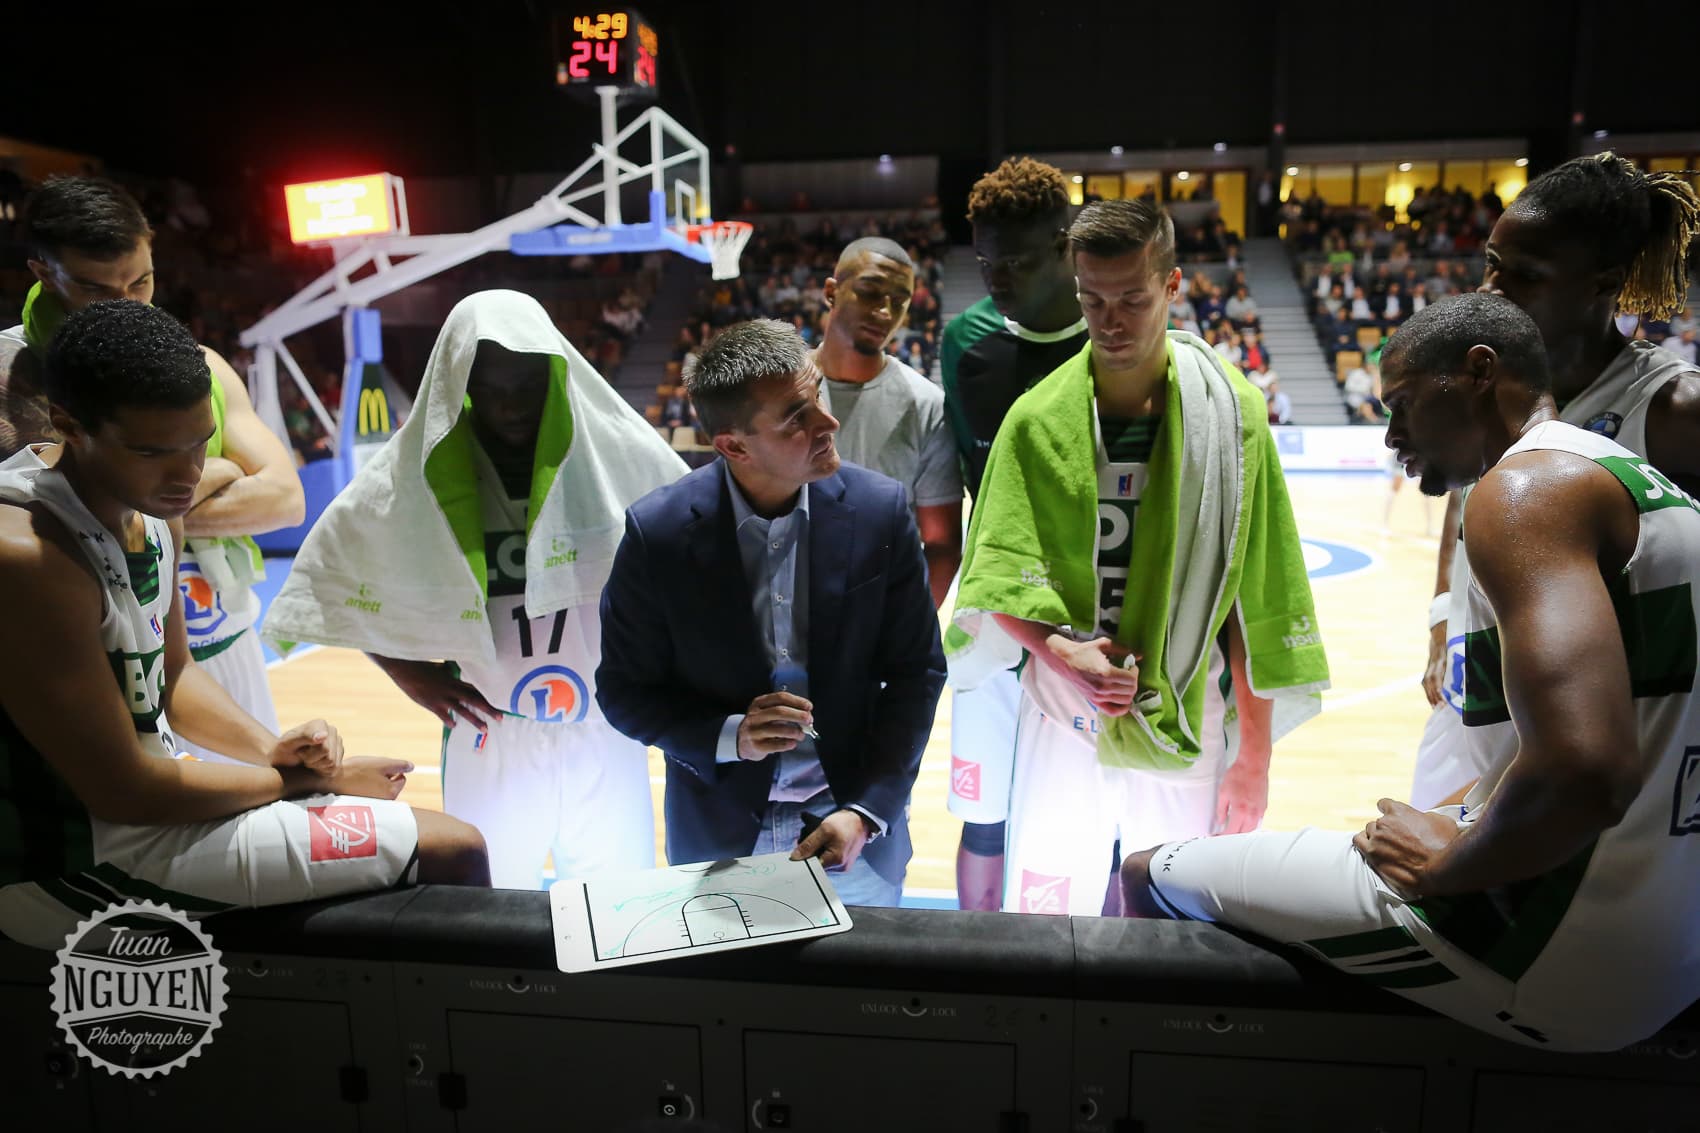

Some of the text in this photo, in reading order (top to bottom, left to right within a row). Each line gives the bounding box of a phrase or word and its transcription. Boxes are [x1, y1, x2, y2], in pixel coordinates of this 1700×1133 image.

[569, 40, 618, 78] 24
[512, 605, 568, 658] 17
[861, 1003, 957, 1017] UNLOCK LOCK
[1163, 1019, 1264, 1033] UNLOCK LOCK
